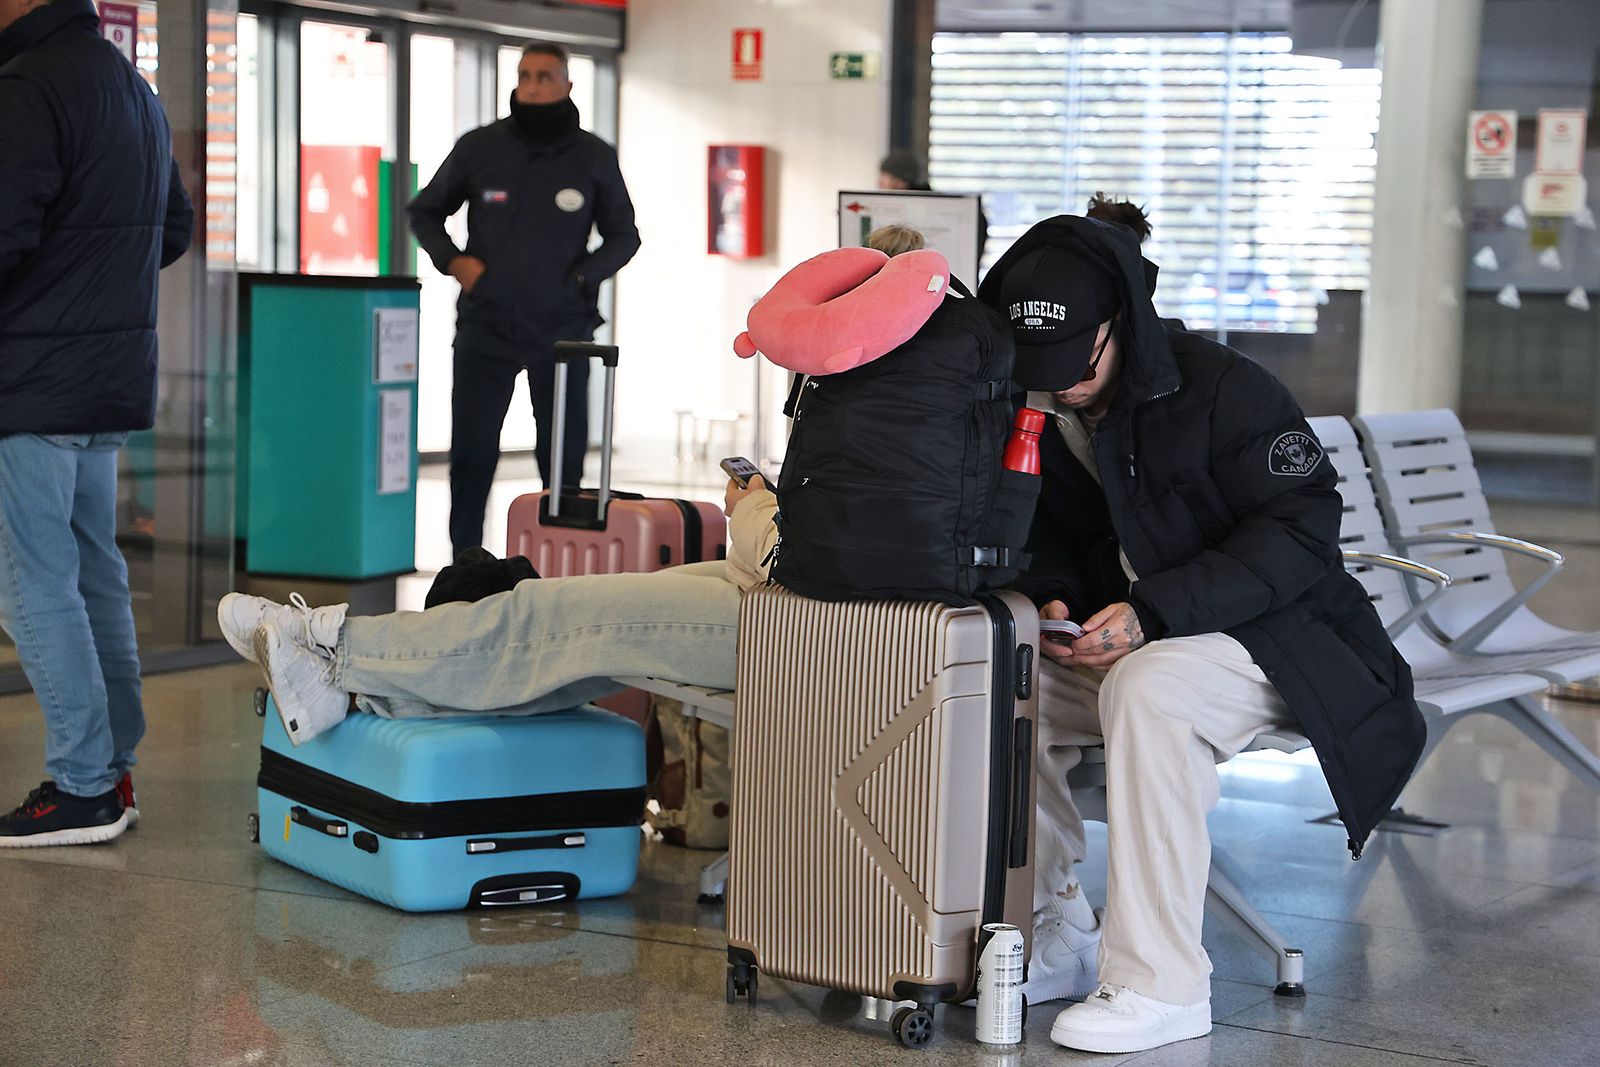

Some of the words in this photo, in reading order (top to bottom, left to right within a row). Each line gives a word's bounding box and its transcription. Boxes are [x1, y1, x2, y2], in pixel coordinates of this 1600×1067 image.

[1009, 302, 1021, 320] LOS
[1023, 301, 1066, 321] ANGELES
[1274, 435, 1309, 456] ZAVETTI
[1281, 452, 1319, 473] CANADA
